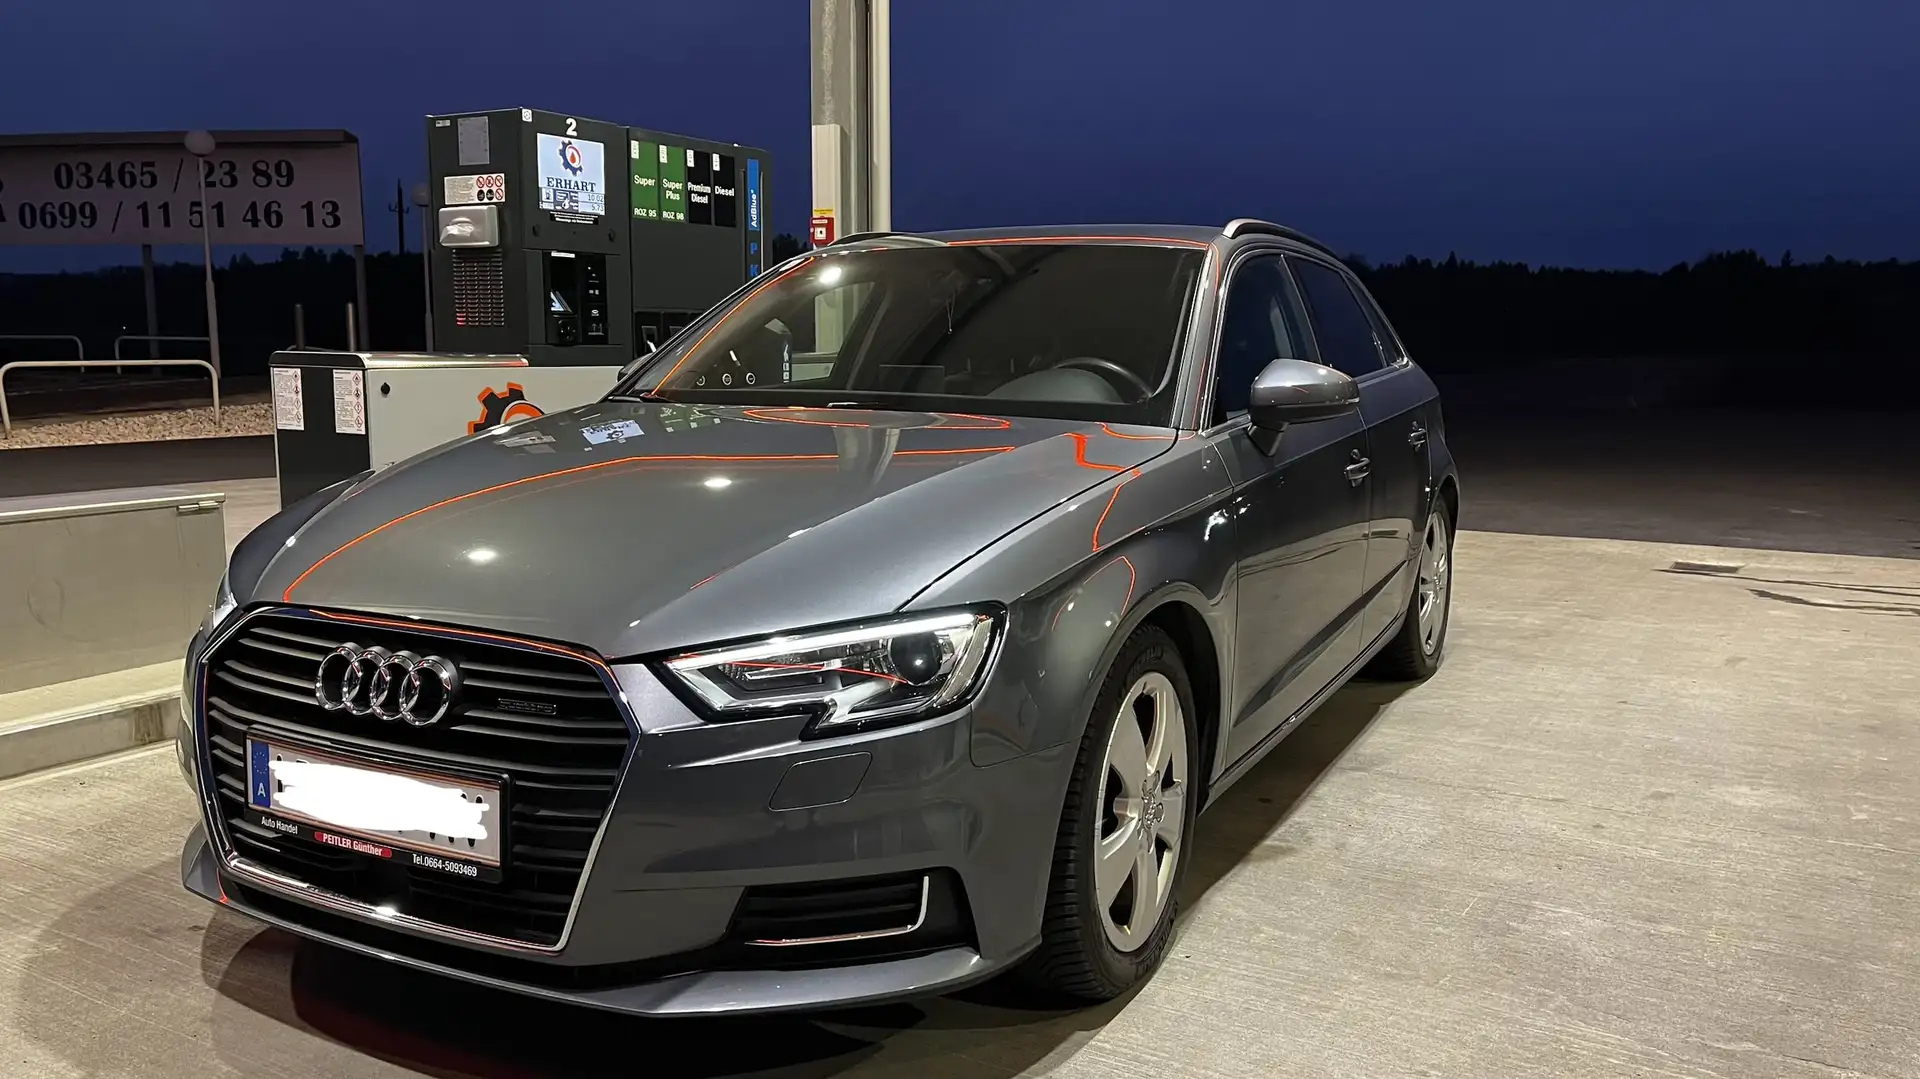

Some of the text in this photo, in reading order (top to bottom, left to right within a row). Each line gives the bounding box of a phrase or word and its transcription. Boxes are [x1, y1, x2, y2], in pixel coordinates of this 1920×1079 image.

[565, 118, 577, 136] 2
[54, 161, 158, 190] 03465
[197, 159, 239, 189] 23
[252, 159, 295, 188] 89
[634, 174, 656, 187] Super
[546, 176, 597, 193] ERHART
[662, 178, 683, 190] Super
[687, 181, 712, 194] Premium
[665, 189, 680, 201] Plus
[714, 185, 735, 197] Diesel
[691, 193, 709, 204] Diesel
[18, 201, 98, 229] 0699
[136, 201, 172, 229] 11
[188, 201, 225, 228] 51
[242, 200, 284, 229] 46
[300, 200, 342, 229] 13
[633, 207, 657, 218] ROZ 95
[662, 210, 676, 219] ROZ
[257, 783, 266, 797] A
[261, 816, 298, 835] Auto Handel
[322, 832, 383, 857] PEITLER Günther
[412, 853, 478, 878] Tel.0664-5093469
